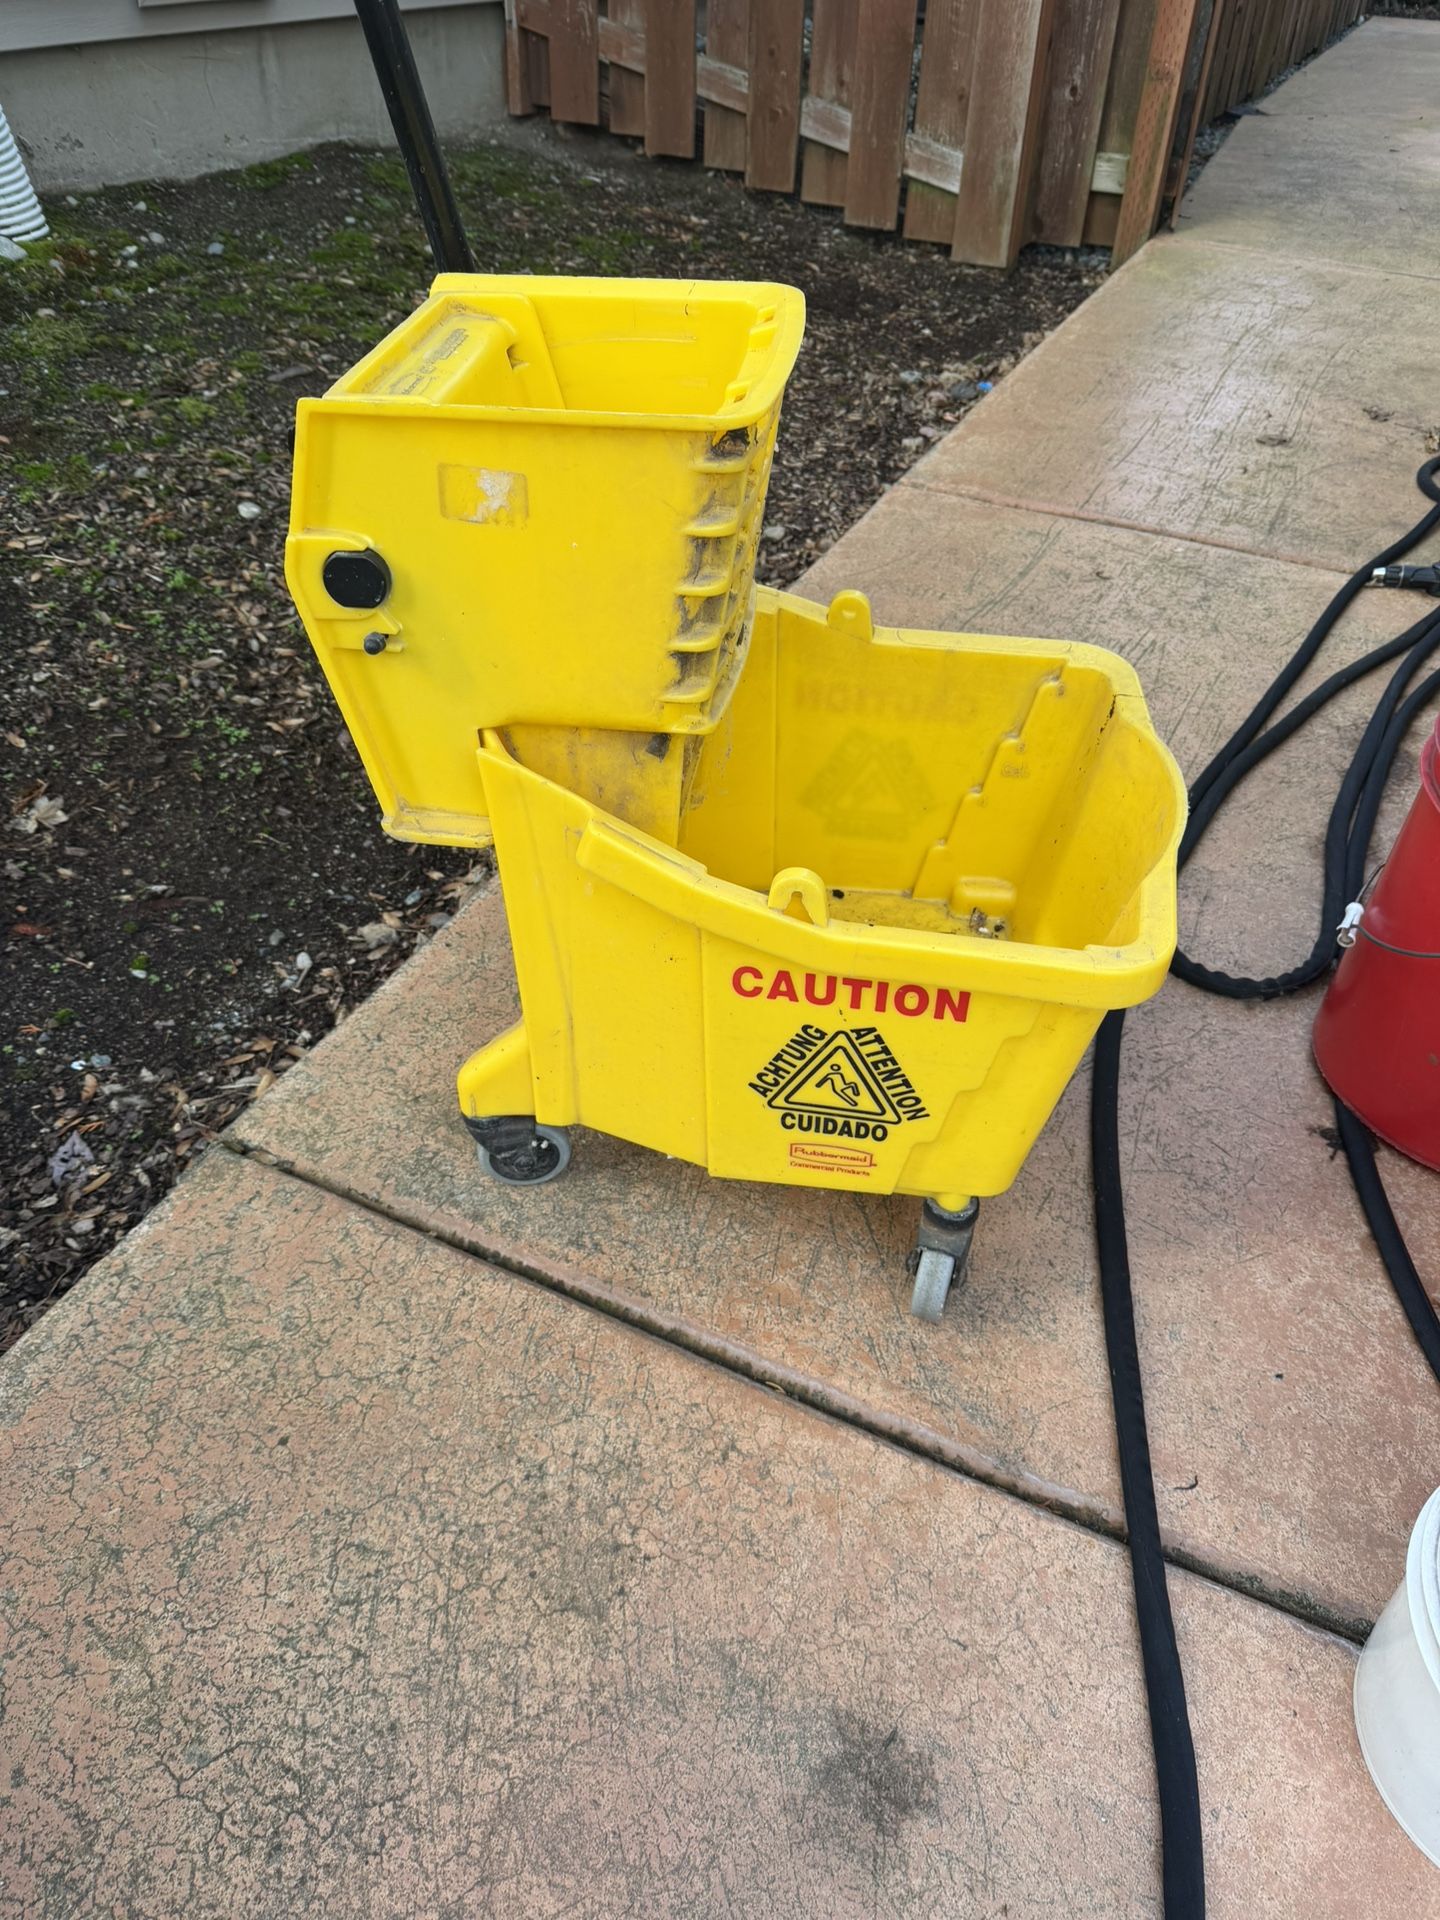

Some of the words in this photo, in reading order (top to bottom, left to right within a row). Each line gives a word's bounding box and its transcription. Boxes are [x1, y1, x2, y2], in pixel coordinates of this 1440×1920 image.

[732, 966, 971, 1022] CAUTION
[748, 1024, 828, 1098] ACHTUNG
[850, 1026, 930, 1121] ATTENTION
[780, 1112, 888, 1141] CUIDADO
[790, 1160, 835, 1172] Commercial
[836, 1166, 871, 1177] Products
[794, 1147, 867, 1163] Rubbermaid
